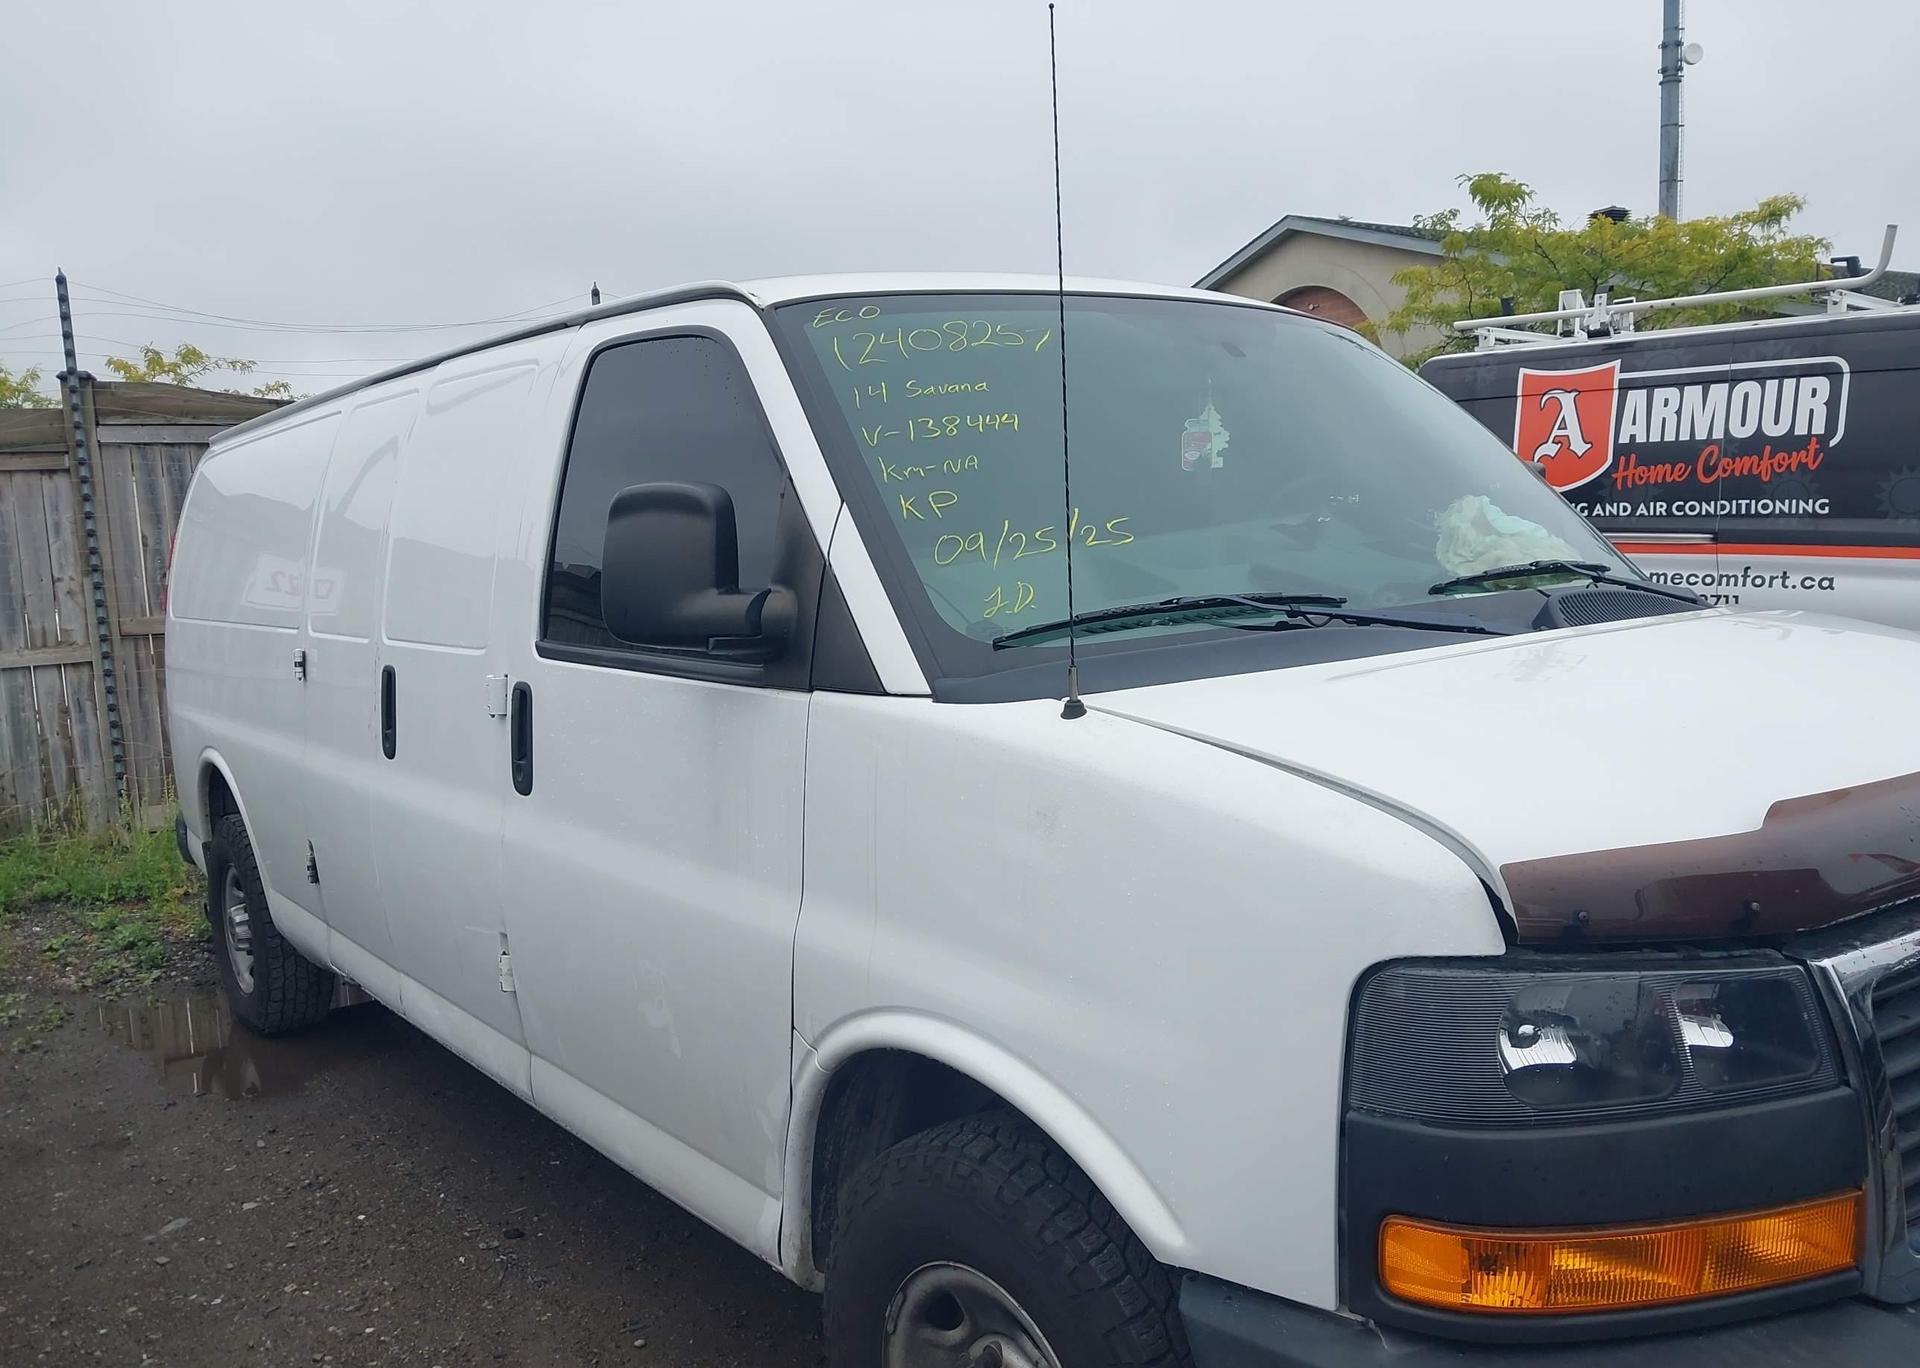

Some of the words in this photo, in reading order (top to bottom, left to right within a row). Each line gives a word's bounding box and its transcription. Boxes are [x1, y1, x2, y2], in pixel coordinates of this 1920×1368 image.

[812, 304, 881, 329] ECO
[853, 381, 888, 409] 14
[905, 379, 990, 398] Savana
[1618, 375, 1831, 444] ARMOUR
[1533, 388, 1593, 463] A
[1612, 453, 1692, 491] Home
[1696, 436, 1824, 484] Comfort
[1571, 502, 1589, 516] G
[1592, 501, 1632, 517] AND
[1635, 501, 1667, 517] AIR
[1671, 498, 1830, 516] CONDITIONING
[934, 508, 1135, 568] 09/25/25
